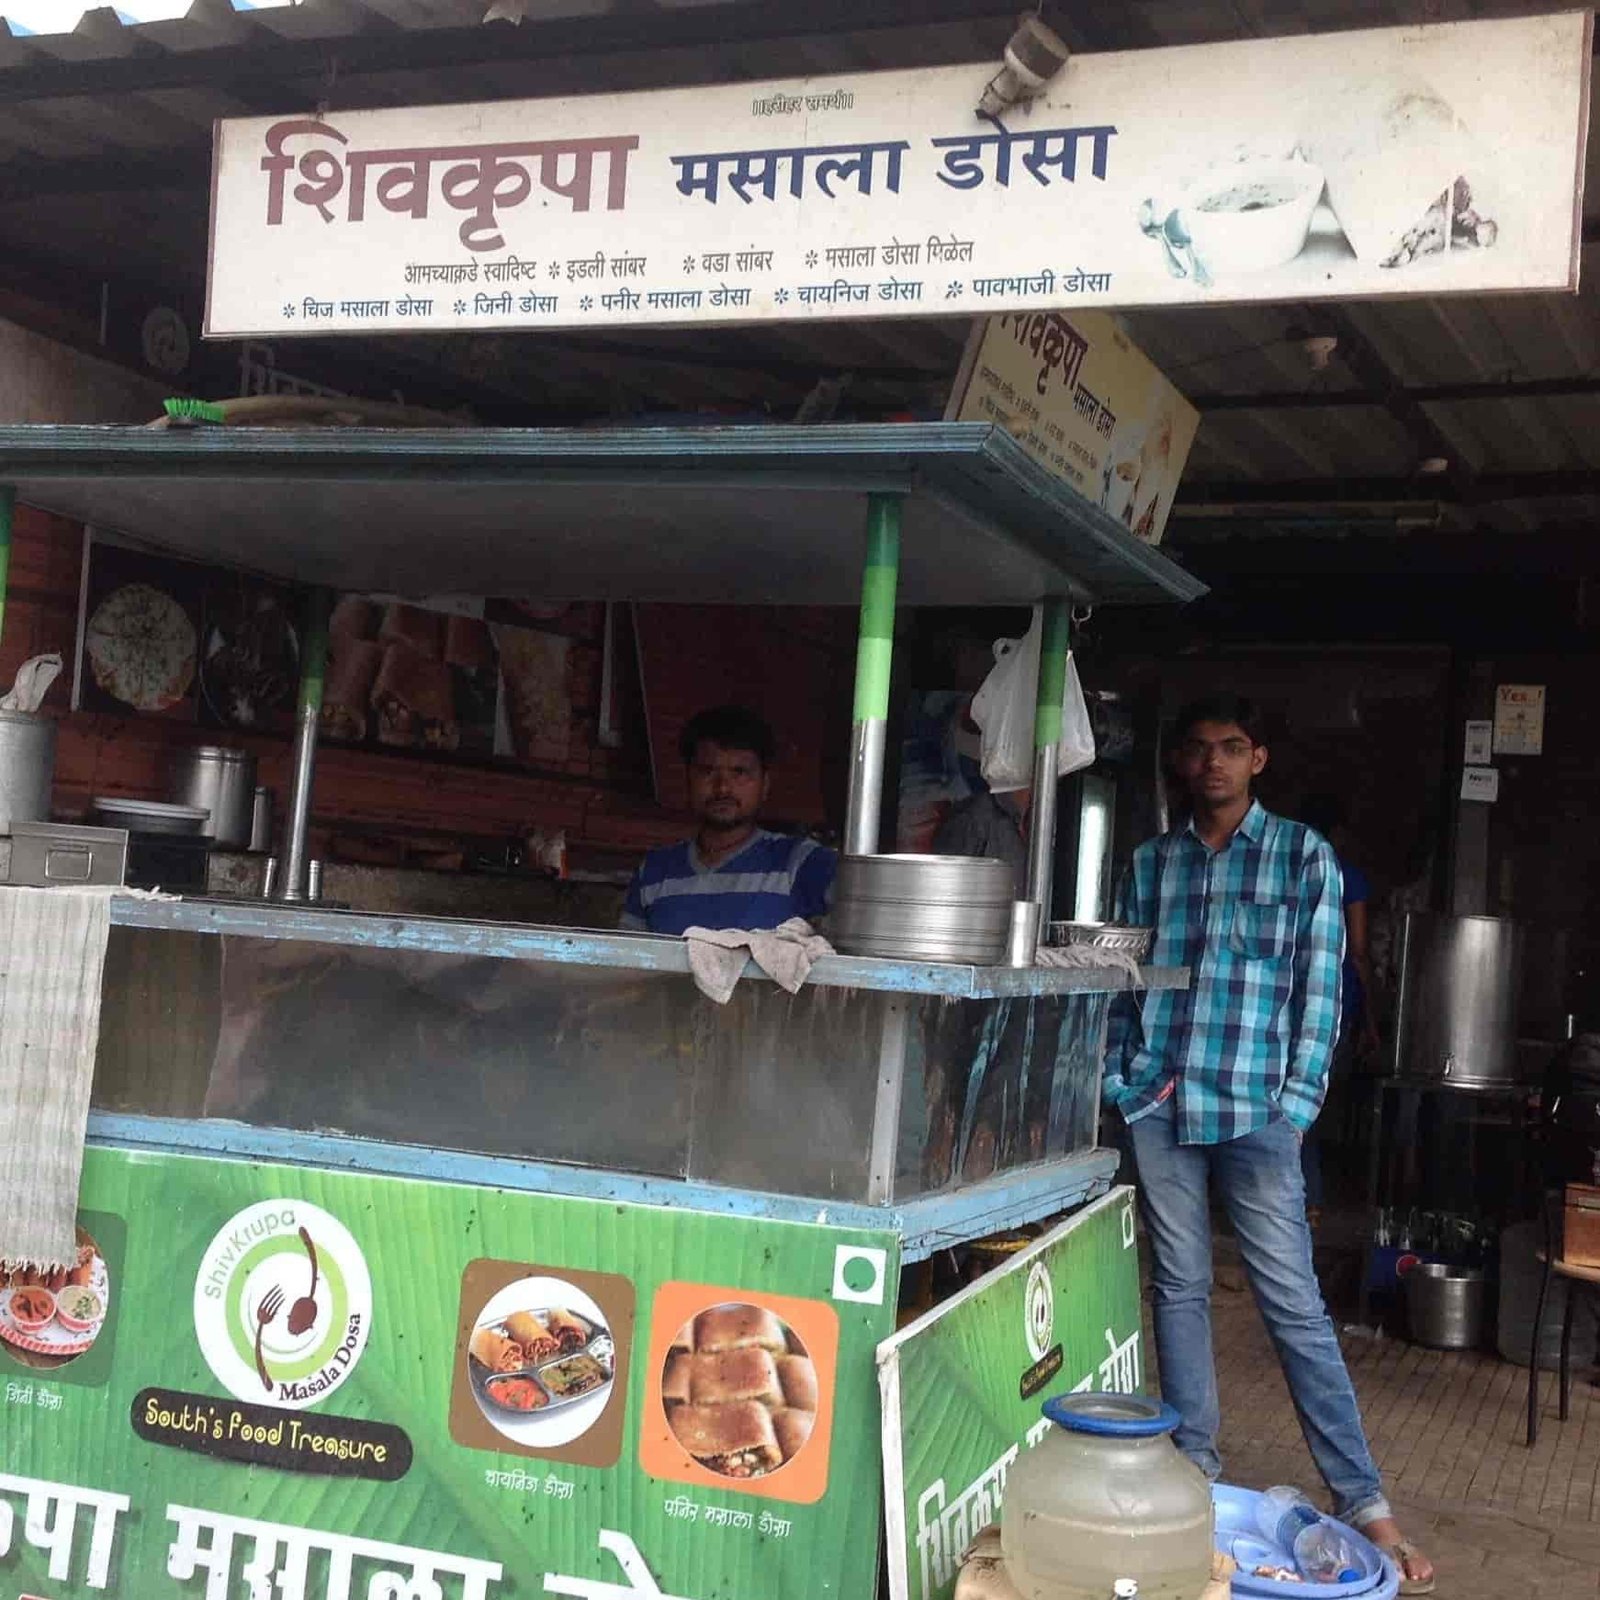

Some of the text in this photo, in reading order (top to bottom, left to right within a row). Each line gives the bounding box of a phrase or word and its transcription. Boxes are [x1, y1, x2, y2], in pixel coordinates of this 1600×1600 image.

[261, 109, 1117, 251] शिवकृपा मसाला डोसा
[302, 266, 1112, 318] चिज मसाला डोसा जिनी डोसा पनीर मसाला डोसा चायनिज डोसा पावभाजी डोसा
[484, 255, 536, 282] स्वादिष्ट
[567, 251, 605, 282] इडली
[610, 250, 647, 278] सांबर
[702, 253, 730, 272] वडा
[735, 244, 773, 273] सांबर
[825, 246, 876, 268] मसाला
[882, 236, 920, 265] डोसा
[205, 1209, 295, 1300] ShivKrupa
[279, 1313, 361, 1401] Masala Dosa
[145, 1398, 224, 1439] South's
[290, 1421, 386, 1463] Treasure
